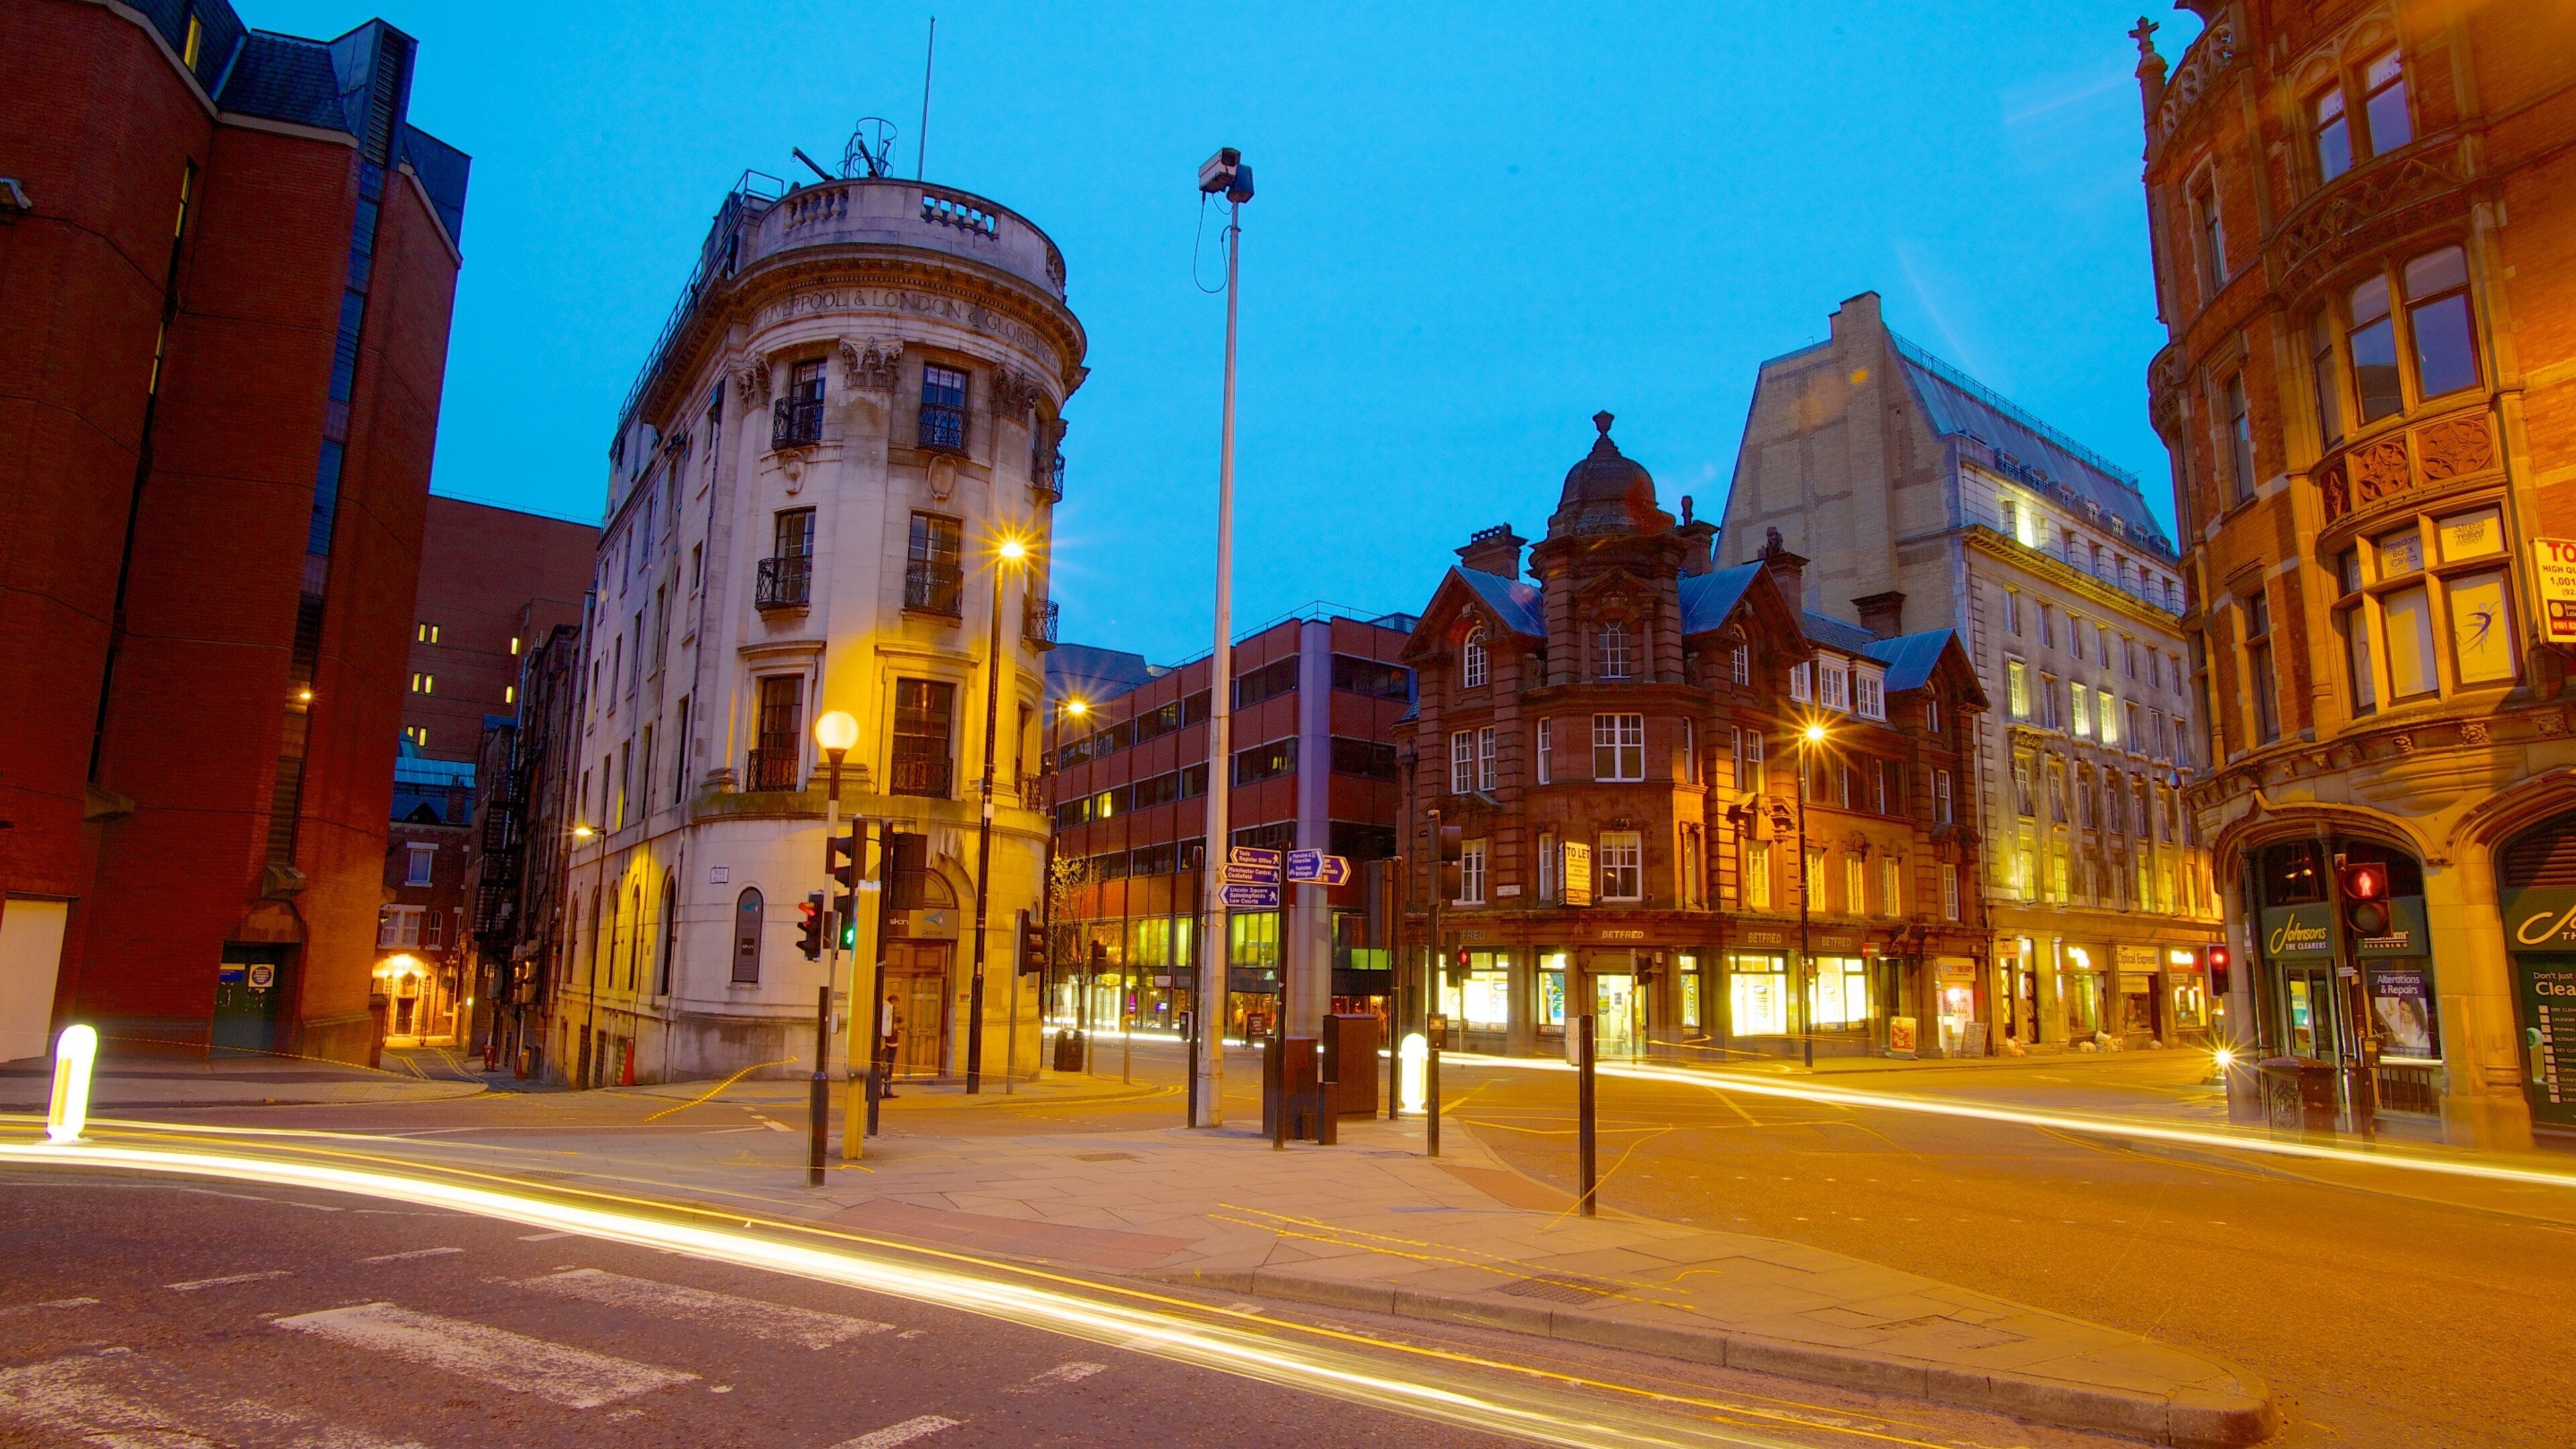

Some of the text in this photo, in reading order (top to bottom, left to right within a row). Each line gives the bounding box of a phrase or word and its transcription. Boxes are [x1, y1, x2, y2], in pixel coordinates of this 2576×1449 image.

[765, 292, 847, 325] LIVERPOOL
[854, 290, 866, 306] &
[873, 290, 961, 319] LONDON
[968, 306, 981, 327] &
[985, 311, 1034, 350] GLOBE
[2455, 520, 2485, 533] Stress
[2457, 529, 2485, 541] relief
[2383, 535, 2421, 549] Freedom
[2392, 546, 2414, 557] Back
[2391, 555, 2418, 568] Clinics
[2542, 565, 2563, 573] HIGH
[2553, 621, 2567, 629] 0161
[1567, 847, 1590, 859] TO LET
[1602, 930, 1644, 939] BETFRED
[1748, 932, 1782, 944] BETFRED
[2269, 912, 2327, 954] Johnsons
[1821, 936, 1851, 947] BETFRED
[2298, 942, 2326, 950] CLEANERS
[2119, 953, 2156, 966] Optical Express
[2377, 975, 2420, 984] Alterations
[2381, 985, 2418, 996] & Repairs
